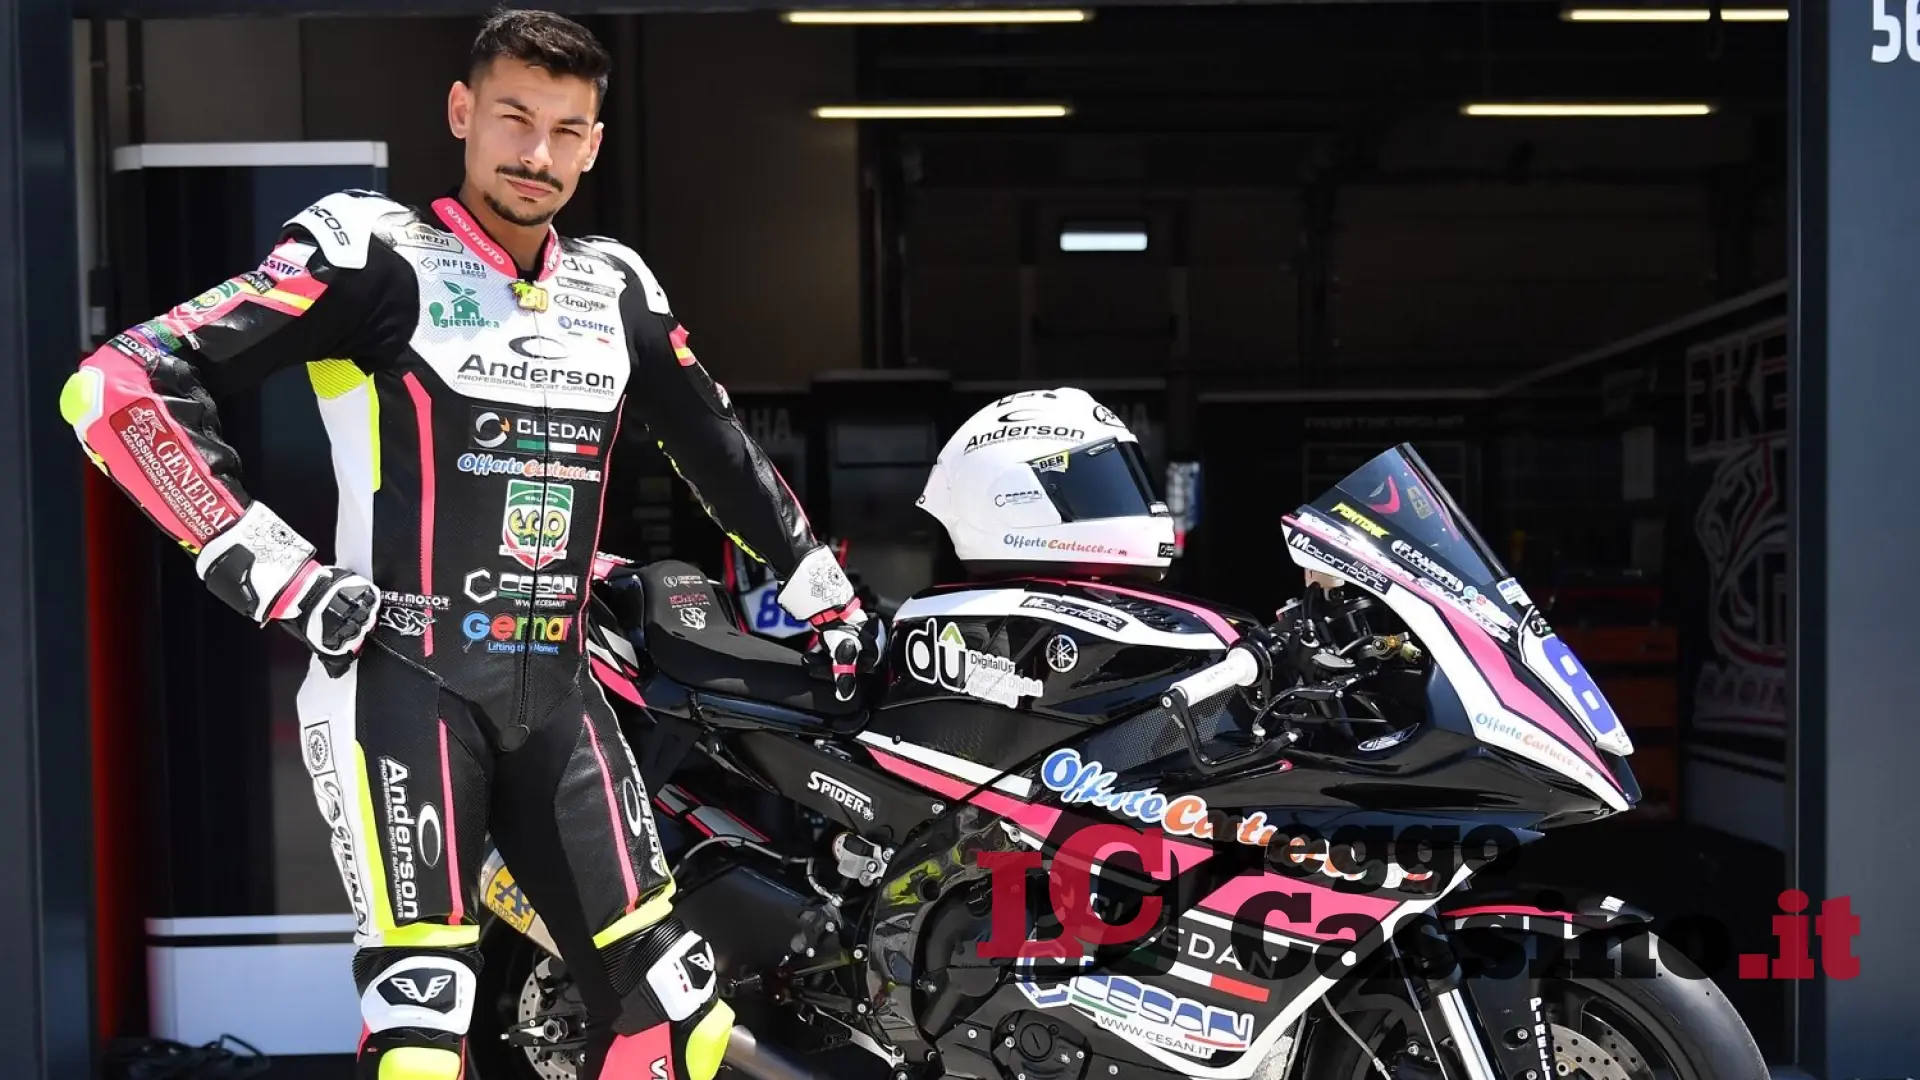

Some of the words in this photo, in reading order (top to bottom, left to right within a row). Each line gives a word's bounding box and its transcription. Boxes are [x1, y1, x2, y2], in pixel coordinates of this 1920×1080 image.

[436, 257, 486, 272] INFISSI
[573, 318, 616, 335] ASSITEC
[457, 374, 528, 389] PROFESSIONAL
[458, 354, 614, 389] Anderson
[516, 418, 601, 442] CLEDAN
[963, 424, 1085, 451] Anderson
[1003, 533, 1128, 557] OfferteCartucce.cm
[488, 642, 515, 653] Lifting
[1475, 712, 1594, 780] OfferteCartucce.cm
[385, 758, 419, 918] Anderson
[1072, 973, 1256, 1050] CESAN
[1100, 1012, 1212, 1058] WWW.CESAN.IT
